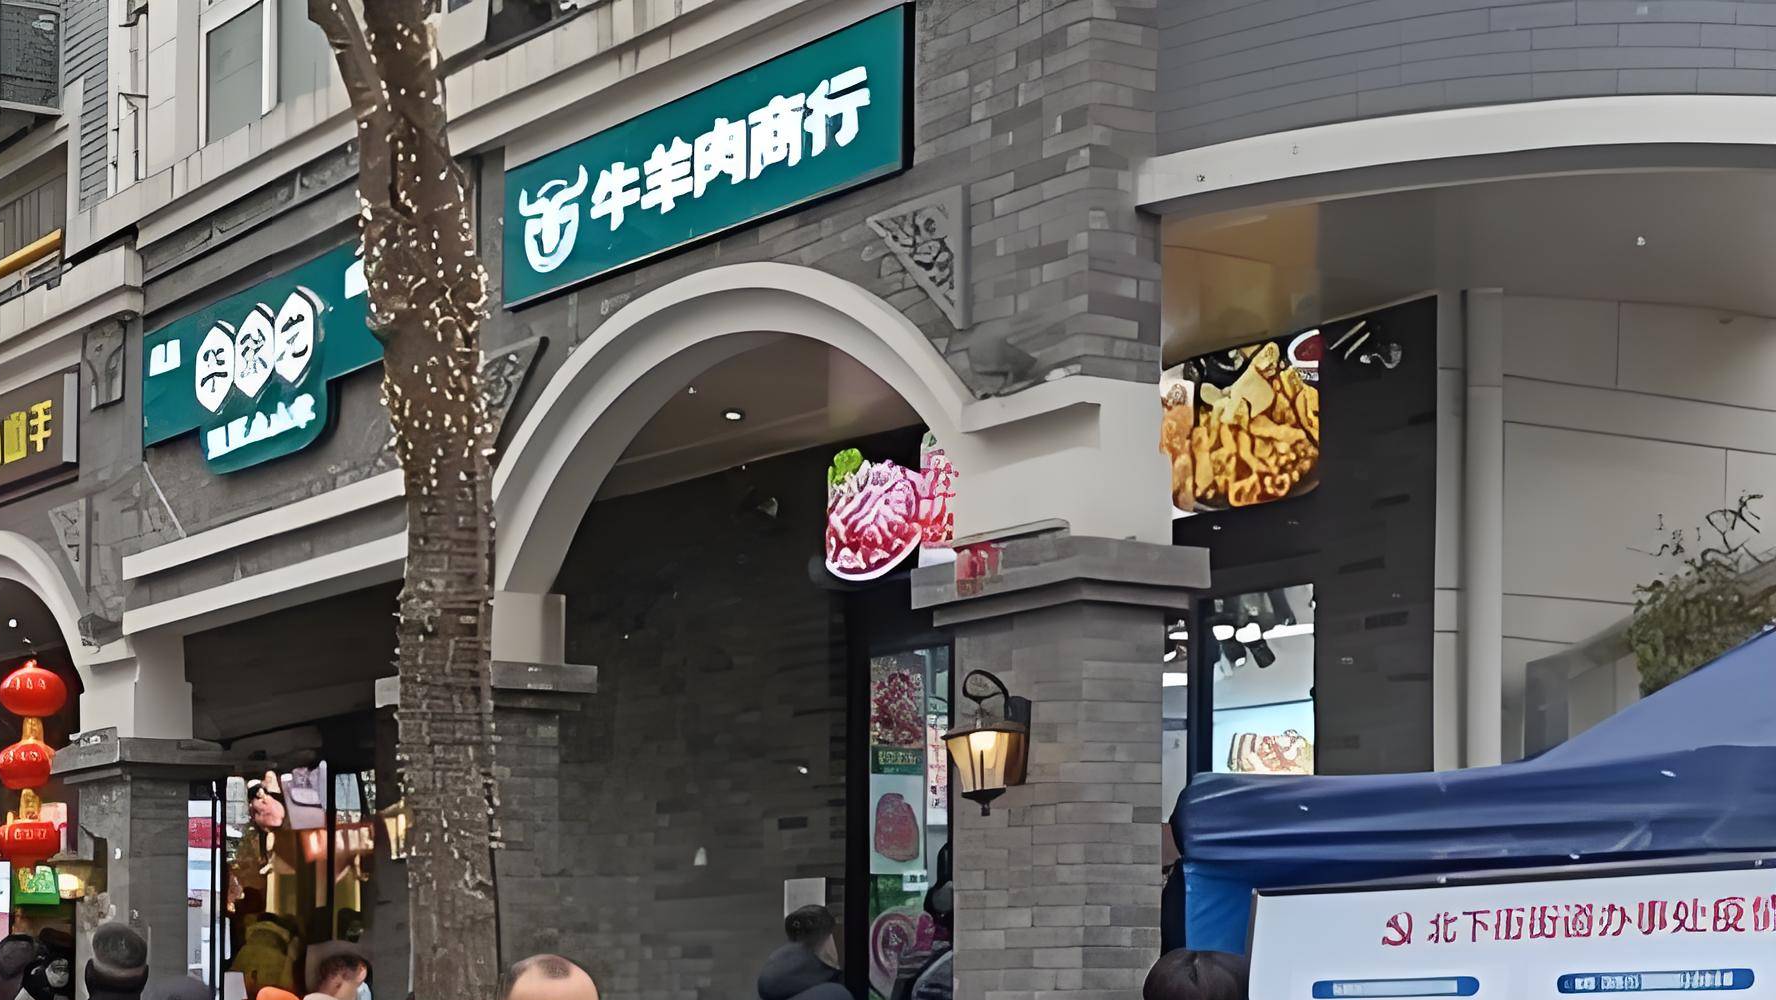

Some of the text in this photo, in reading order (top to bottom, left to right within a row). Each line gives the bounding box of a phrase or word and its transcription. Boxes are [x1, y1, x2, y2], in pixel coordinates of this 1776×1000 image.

[590, 66, 871, 231] 牛羊肉商行
